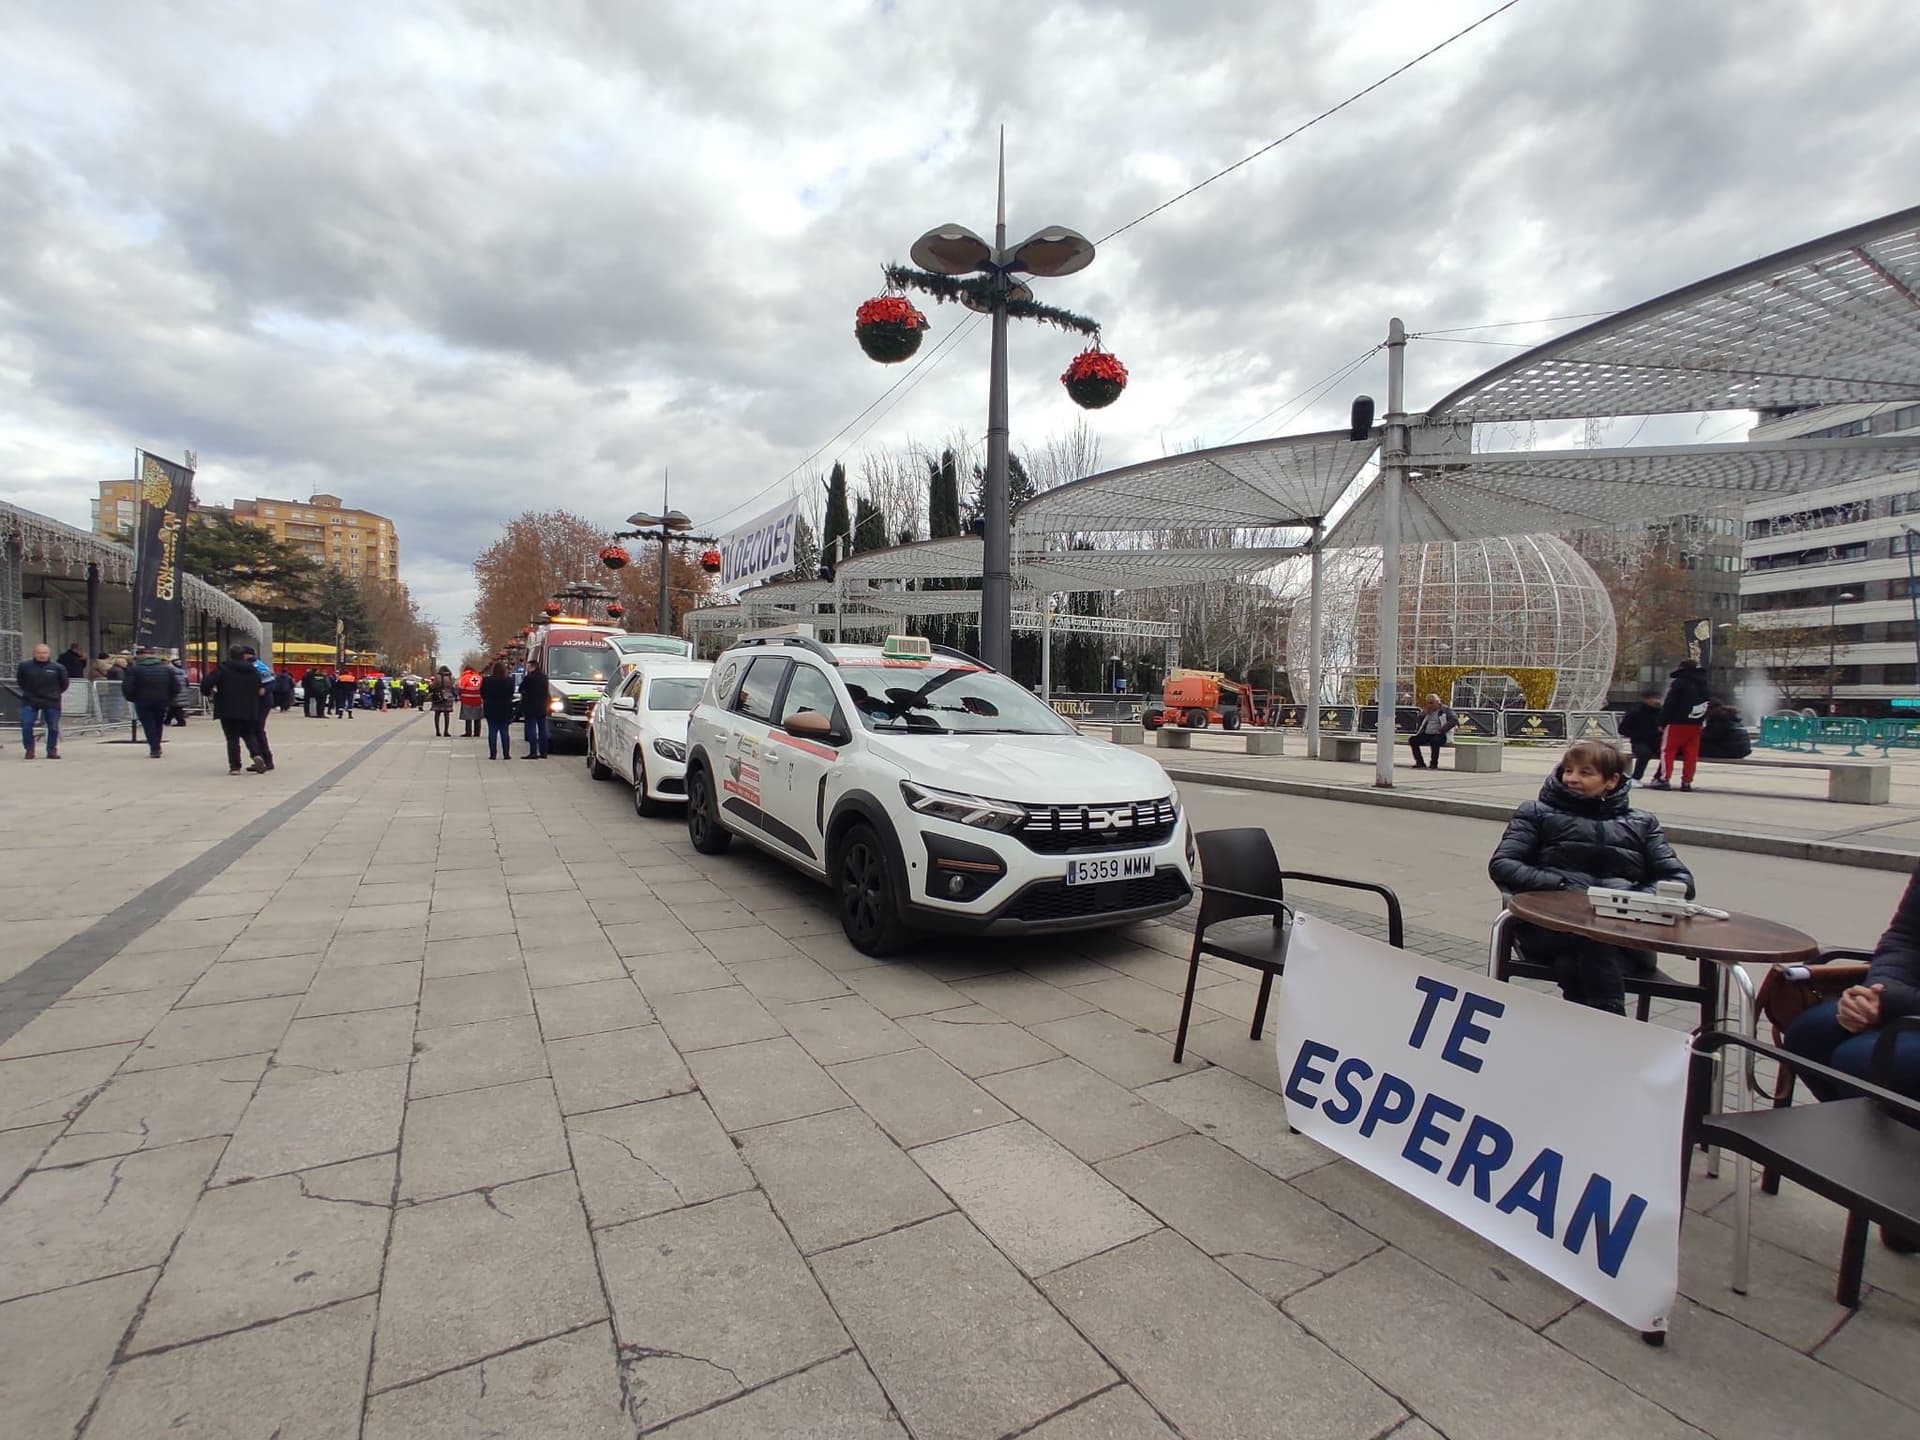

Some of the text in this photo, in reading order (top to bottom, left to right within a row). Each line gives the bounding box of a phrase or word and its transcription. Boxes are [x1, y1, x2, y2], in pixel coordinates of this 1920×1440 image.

[721, 513, 794, 585] TÚ DECIDES
[1053, 701, 1093, 715] RURAL
[1079, 856, 1151, 880] 5359 MMM
[1408, 976, 1505, 1073] TE
[1285, 1040, 1648, 1279] ESPERAN
